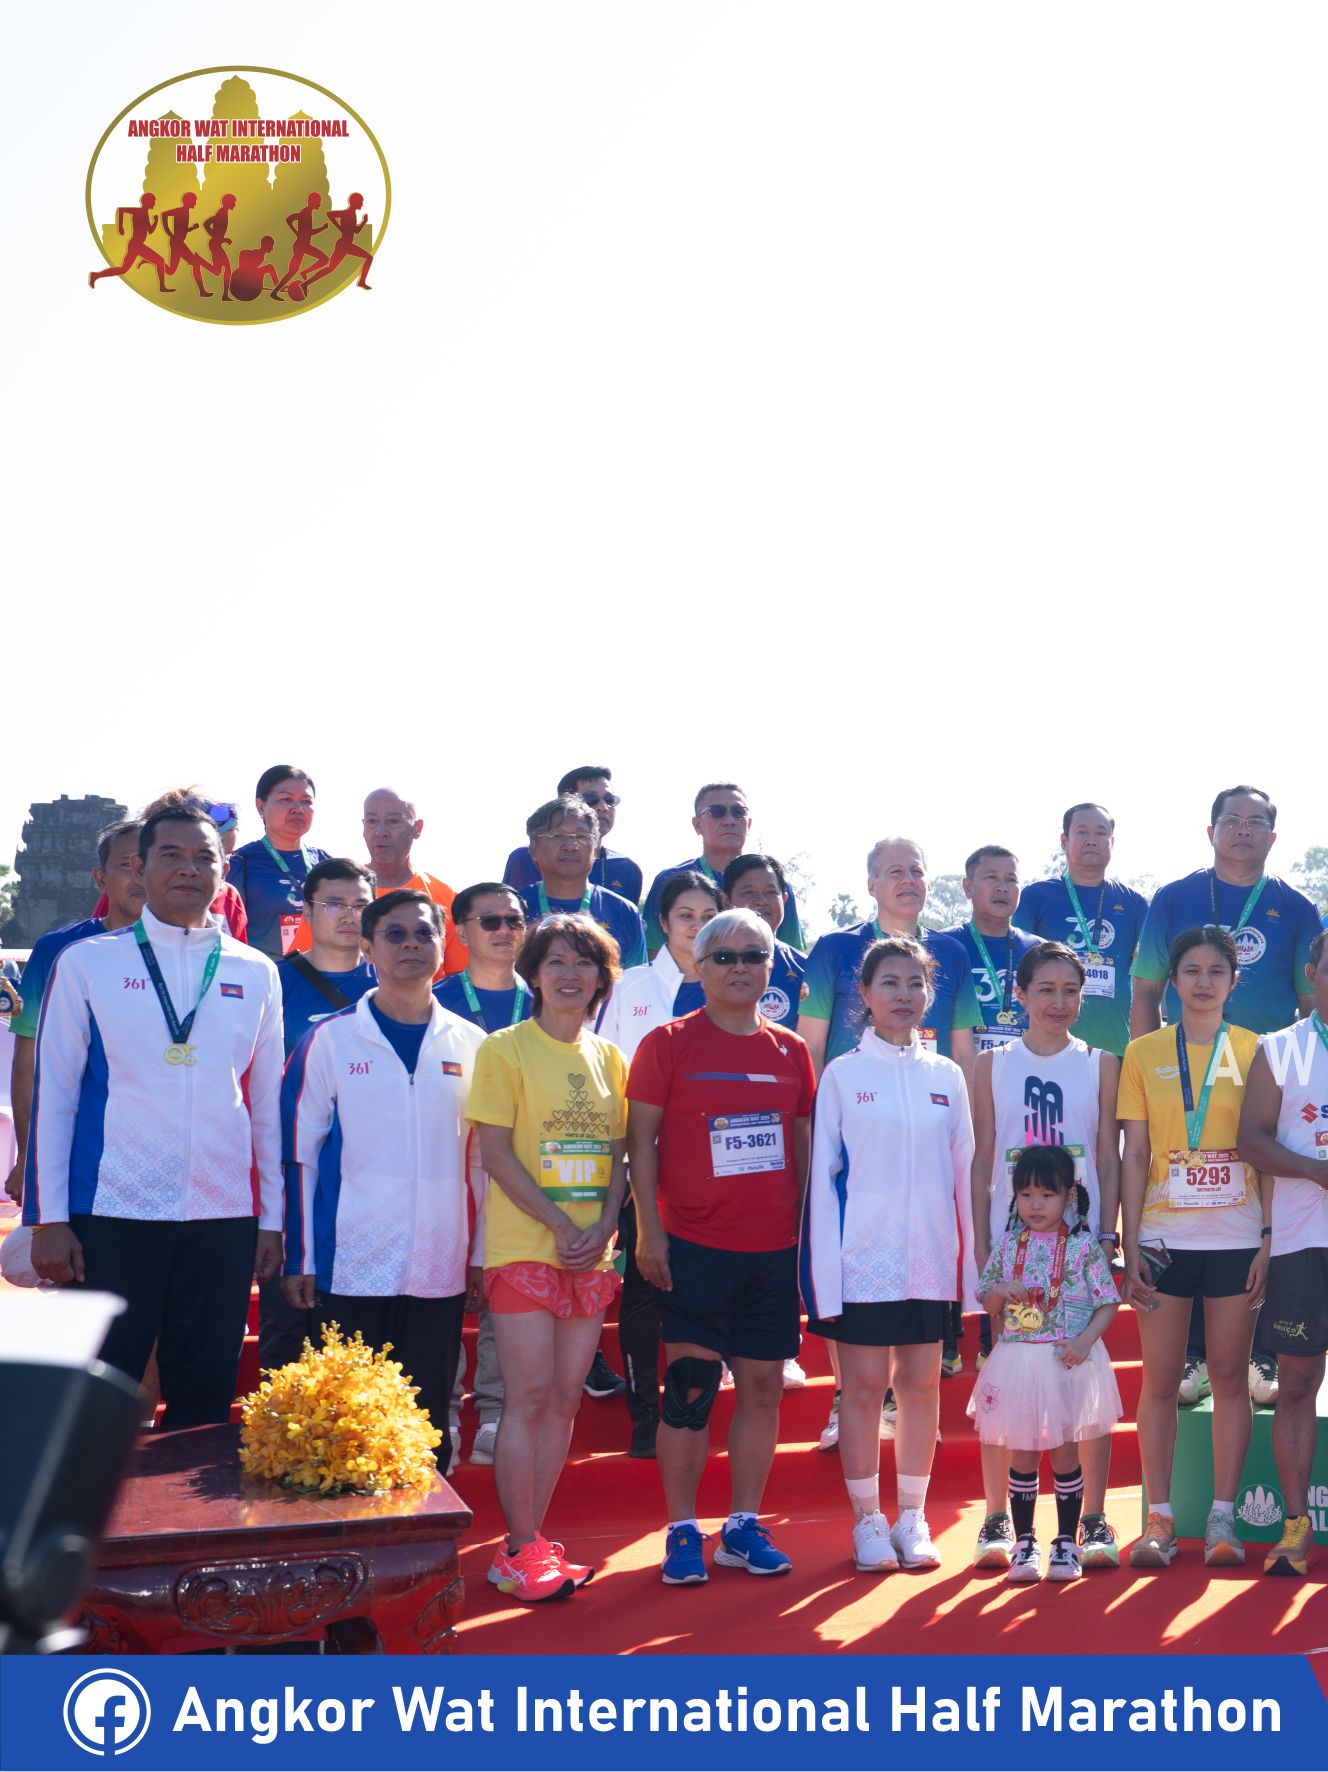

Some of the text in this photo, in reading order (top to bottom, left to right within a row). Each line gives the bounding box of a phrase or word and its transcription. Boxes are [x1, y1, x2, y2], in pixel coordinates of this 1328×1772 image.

[725, 1132, 777, 1150] F5-3621
[558, 1159, 597, 1184] VIP
[1186, 1166, 1231, 1186] 5293
